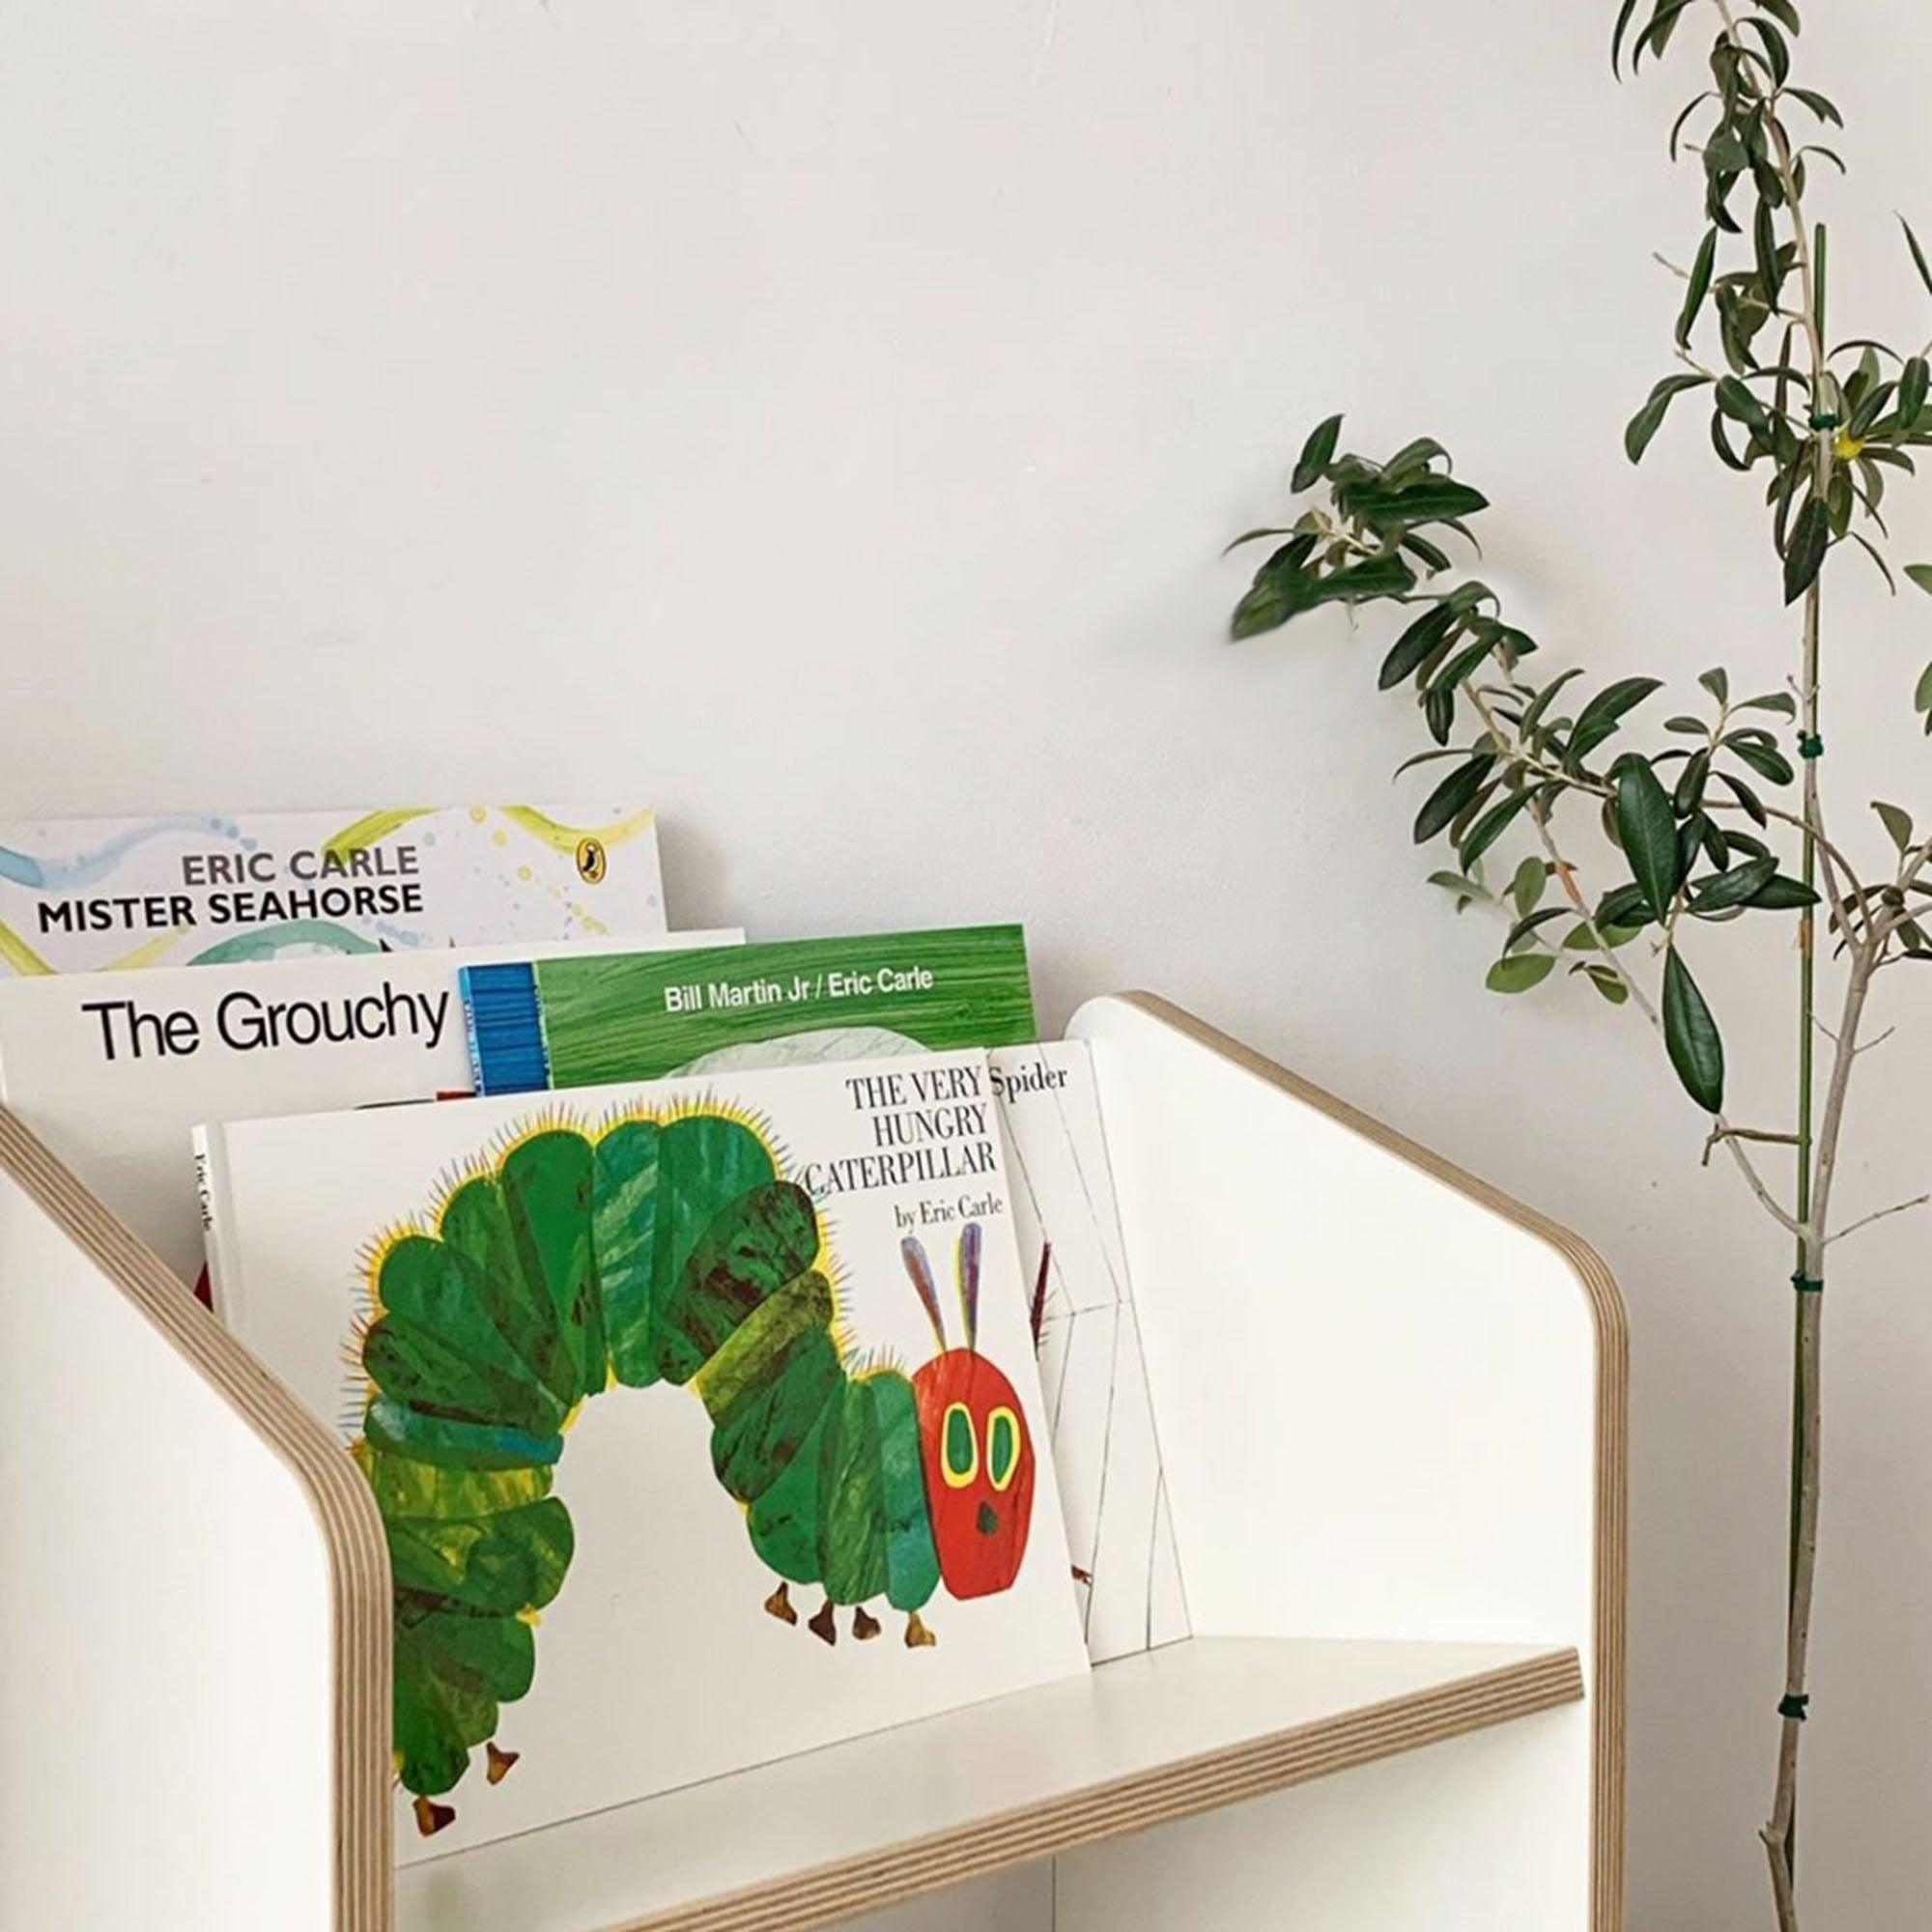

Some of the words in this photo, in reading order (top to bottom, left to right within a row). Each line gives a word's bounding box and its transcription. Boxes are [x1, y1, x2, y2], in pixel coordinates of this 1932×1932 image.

[183, 853, 276, 886] ERIC
[290, 846, 419, 880] CARLE
[38, 895, 197, 933] MISTER
[208, 884, 423, 923] SEAHORSE
[664, 985, 702, 1011] Bill
[708, 979, 781, 1009] Martin
[788, 976, 810, 1001] Jr
[828, 971, 871, 997] Eric
[877, 966, 933, 993] Carle
[82, 1000, 199, 1061] The
[217, 981, 449, 1050] Grouchy
[845, 1073, 907, 1111] THE
[911, 1065, 981, 1103] VERY
[989, 1063, 1067, 1103] Spider
[873, 1103, 987, 1148] HUNGRY
[805, 1141, 997, 1196] CATERPILLAR
[895, 1205, 918, 1232] by
[921, 1200, 955, 1226] Eric
[957, 1191, 1004, 1218] Carle
